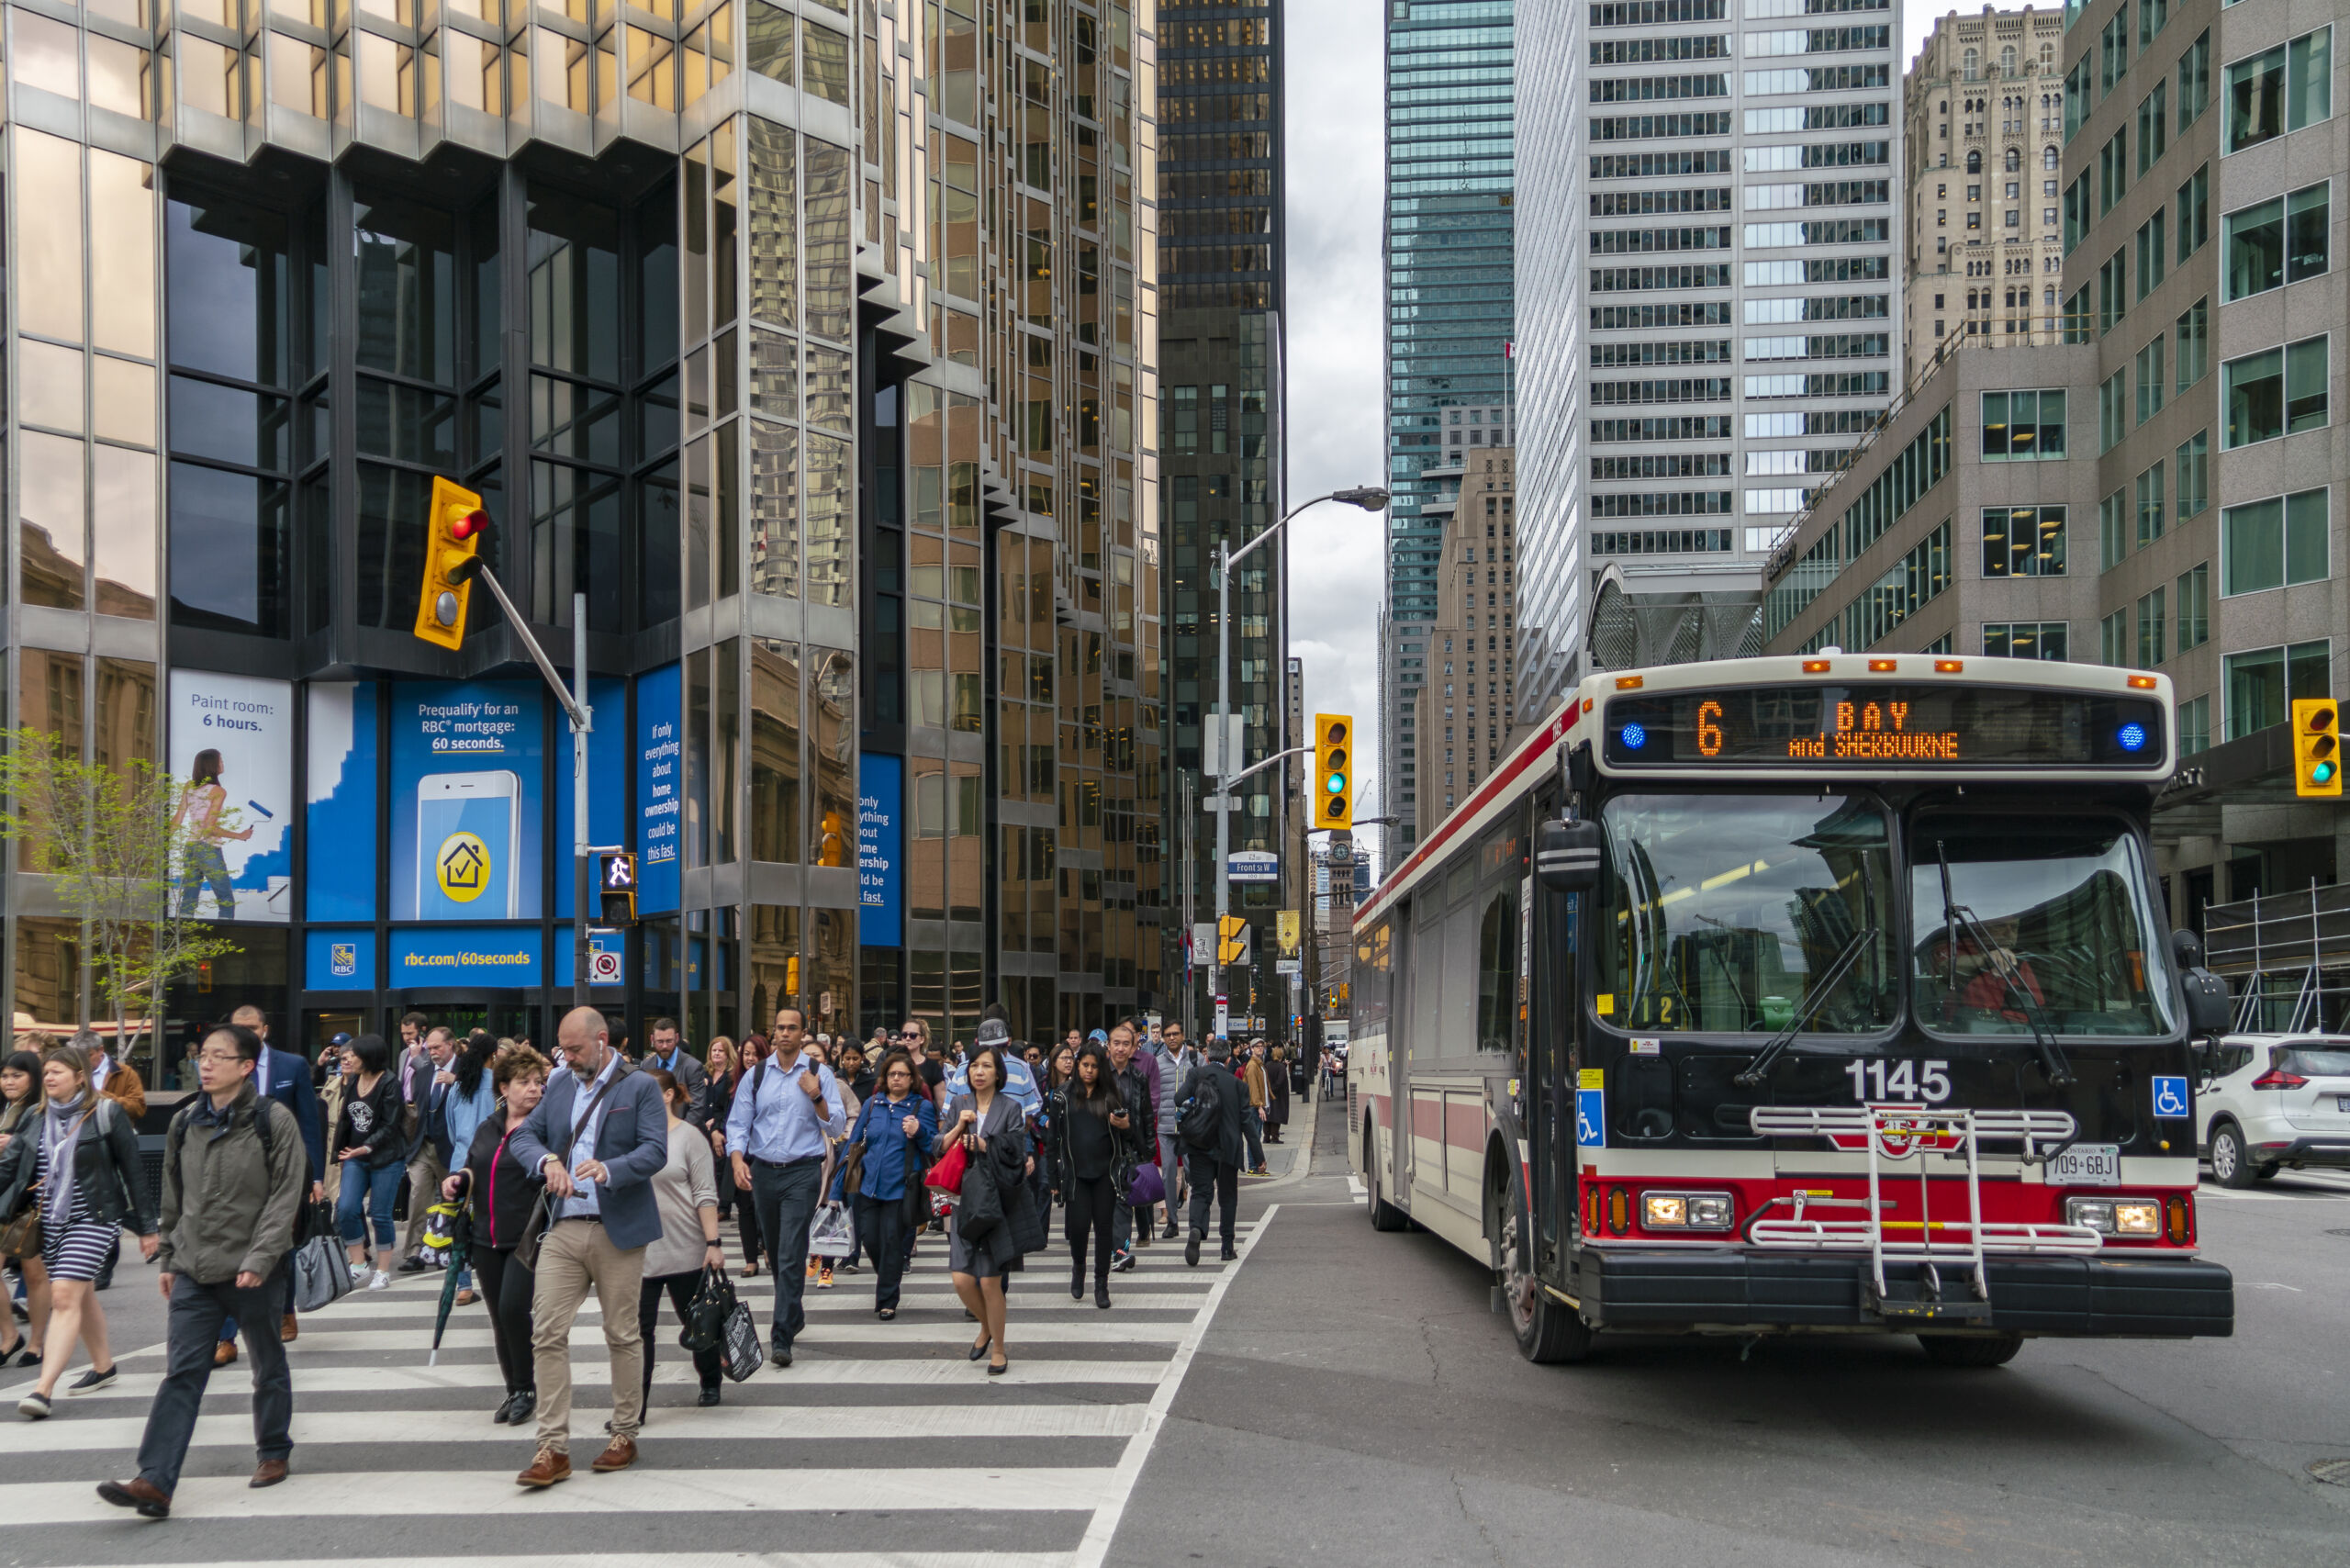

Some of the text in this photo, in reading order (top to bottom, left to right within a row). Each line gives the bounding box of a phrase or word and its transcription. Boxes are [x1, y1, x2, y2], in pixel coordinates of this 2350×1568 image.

[191, 693, 274, 715] Paint room:
[484, 702, 501, 715] for
[504, 704, 519, 715] an
[203, 713, 263, 732] 6 hours.
[1837, 701, 1908, 731] BAY
[453, 721, 515, 735] mortgage:
[652, 721, 672, 739] If only
[1698, 700, 1722, 756] 6
[431, 736, 505, 750] 60 seconds.
[644, 740, 679, 761] everything
[1835, 732, 1958, 759] SHERBOURNE
[652, 761, 672, 778] about
[653, 783, 672, 798] home
[644, 797, 679, 818] ownership
[648, 821, 676, 839] could be
[647, 843, 676, 861] this fast.
[1237, 863, 1256, 872] Front
[1263, 863, 1270, 872] W
[872, 873, 884, 887] be
[863, 890, 884, 903] fast.
[405, 951, 530, 968] rbc.com/60seconds
[334, 965, 352, 973] RBC
[1845, 1058, 1951, 1102] 1145
